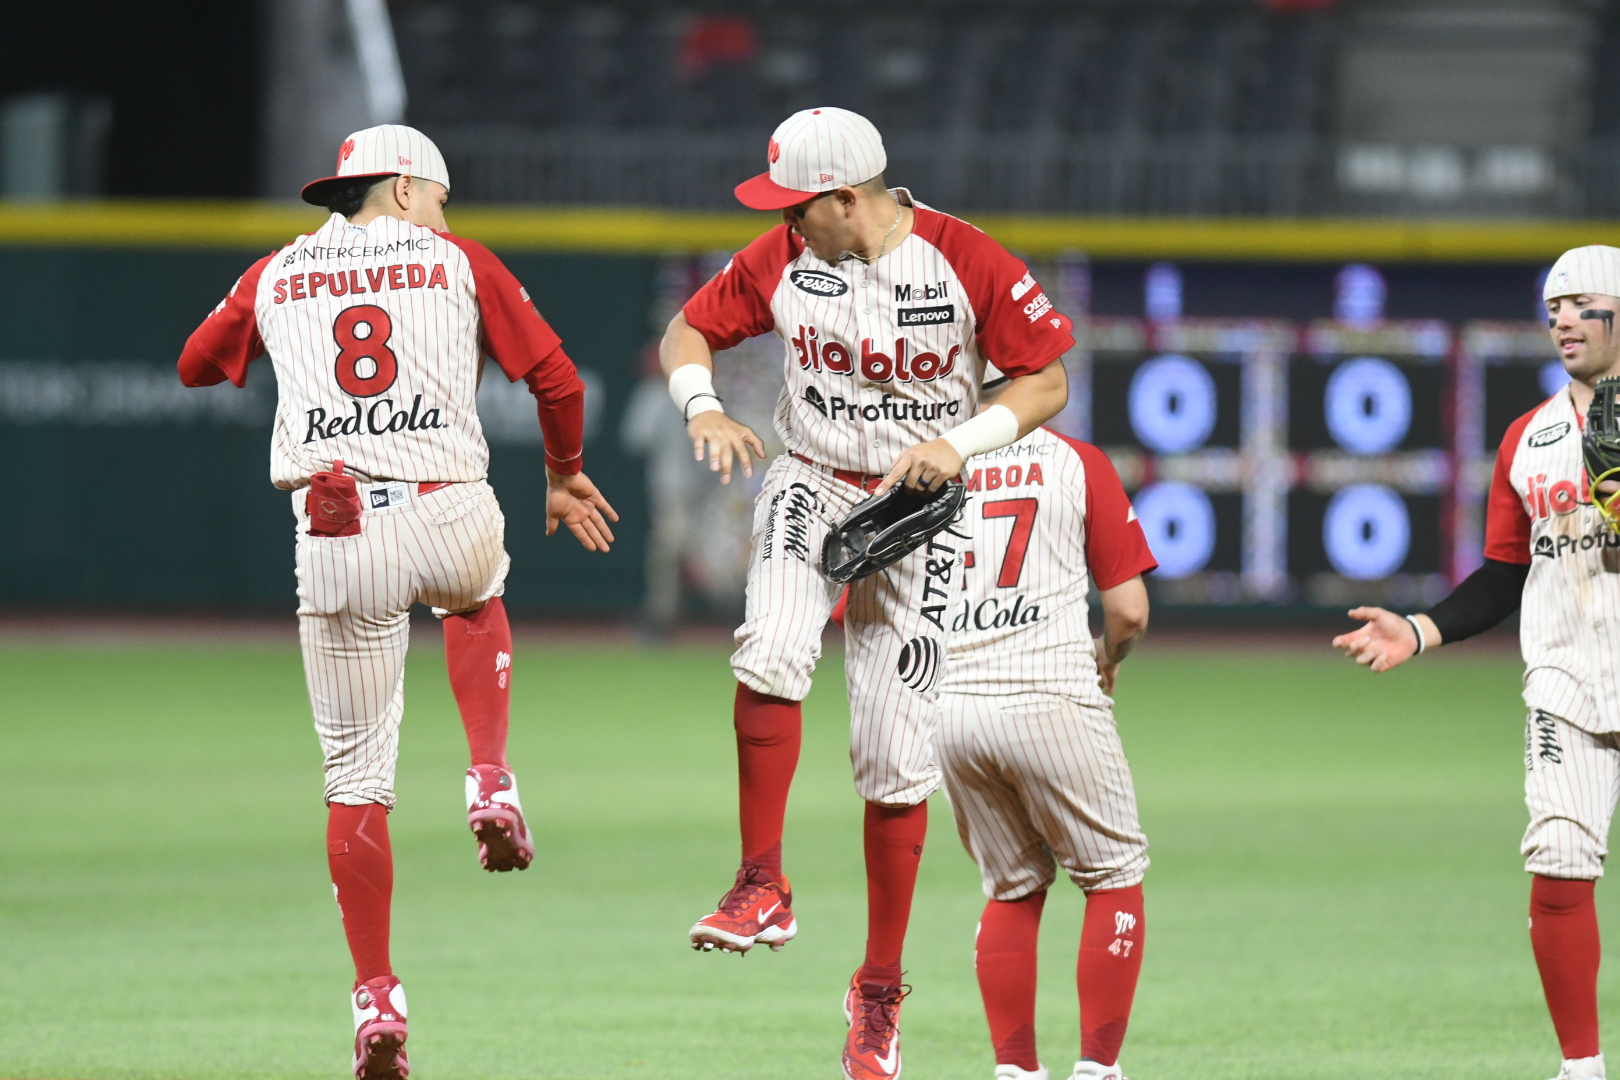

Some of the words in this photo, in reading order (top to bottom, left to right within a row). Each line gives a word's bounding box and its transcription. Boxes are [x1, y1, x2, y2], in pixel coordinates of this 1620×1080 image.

[298, 238, 430, 262] INTERCERAMIC
[273, 262, 449, 305] SEPULVEDA
[794, 271, 843, 296] Fester
[895, 281, 948, 302] Mobil
[902, 310, 950, 323] Lenovo
[333, 303, 399, 399] 8
[830, 394, 960, 422] Profuturo
[967, 463, 1044, 492] MBOA
[1556, 524, 1620, 558] Profu
[920, 537, 956, 632] AT&T
[1108, 938, 1134, 957] 47
